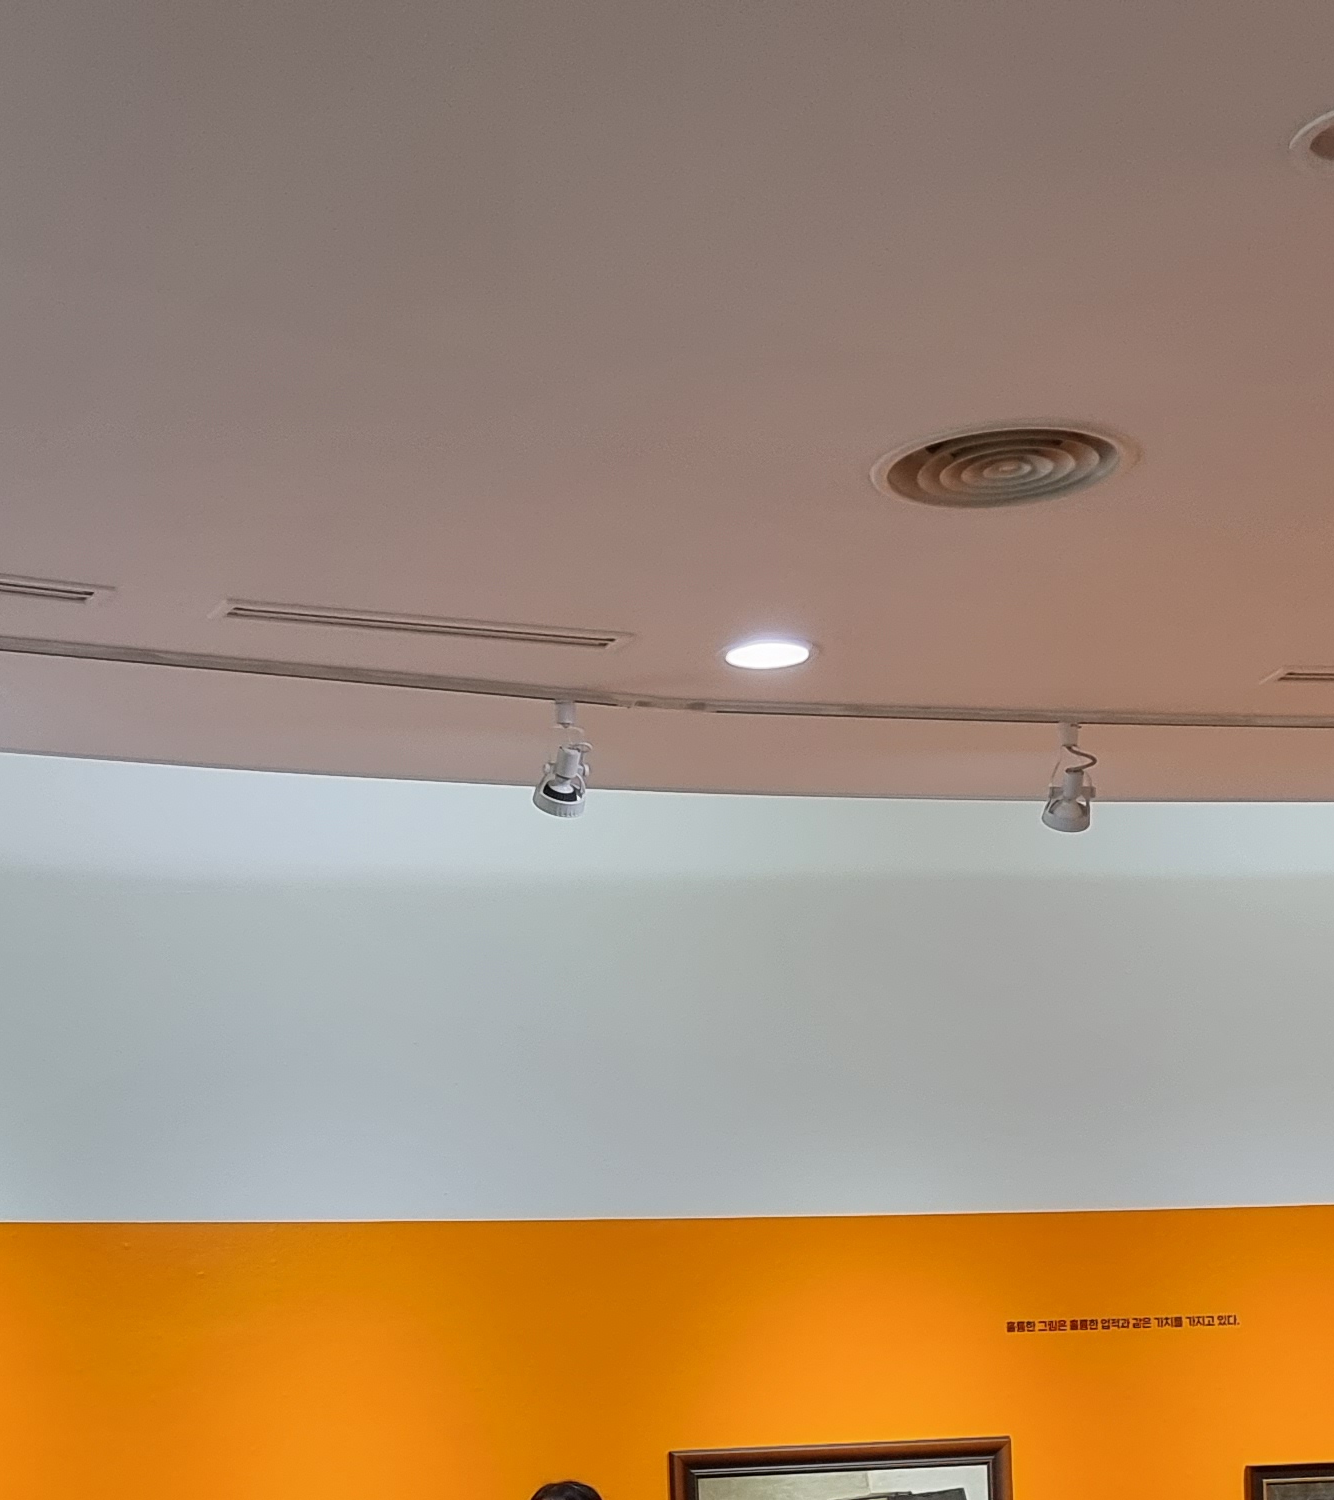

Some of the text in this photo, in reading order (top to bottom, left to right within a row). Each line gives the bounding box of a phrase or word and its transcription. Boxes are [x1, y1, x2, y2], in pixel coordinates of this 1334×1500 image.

[1006, 1315, 1240, 1333] 훌륭한 그림은 훌륭한 업적과 같은 가치를 가지고 있다.
